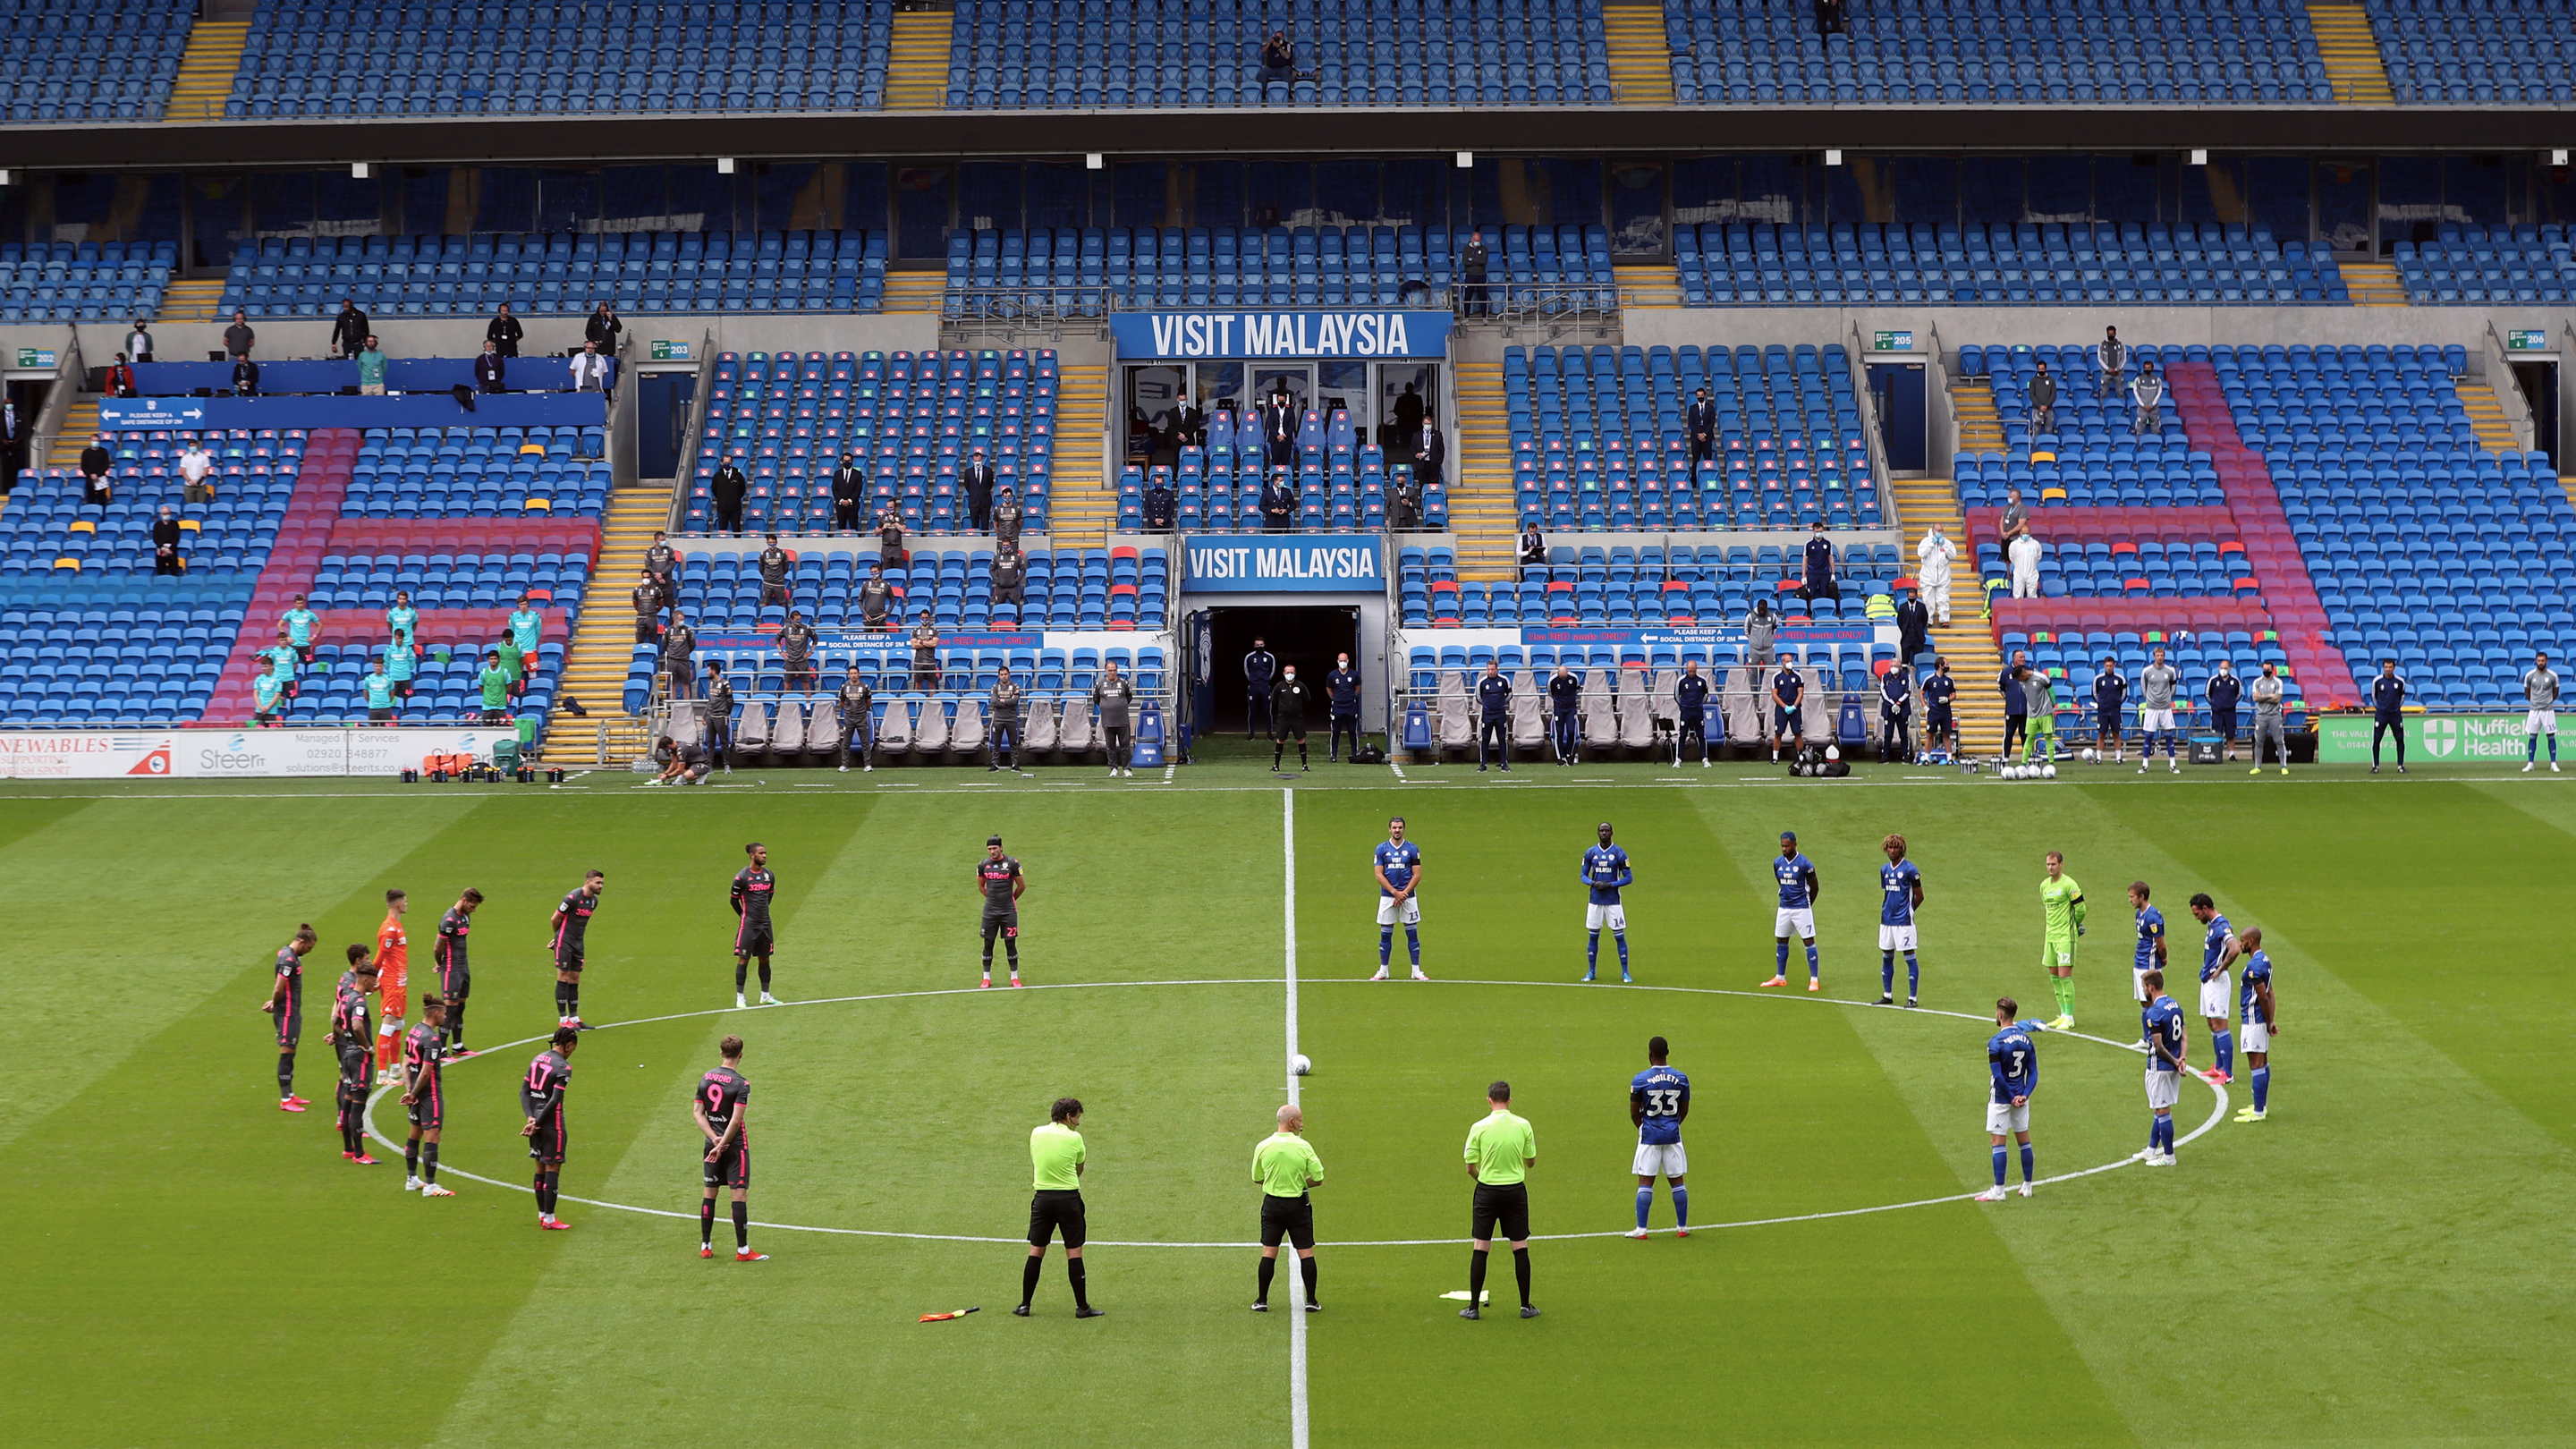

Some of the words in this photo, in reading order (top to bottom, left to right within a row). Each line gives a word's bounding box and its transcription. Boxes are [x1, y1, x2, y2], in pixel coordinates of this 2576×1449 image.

[1151, 315, 1235, 356] VISIT
[1244, 314, 1409, 355] MALAYSIA
[1894, 336, 1911, 344] 205
[2528, 335, 2544, 343] 206
[671, 345, 688, 354] 203
[1190, 548, 1250, 579] VISIT
[1256, 547, 1375, 578] MALAYSIA
[1528, 632, 1546, 640] Use
[1548, 632, 1570, 640] RED
[1572, 632, 1598, 640] seats
[1784, 631, 1806, 639] RED
[696, 639, 715, 647] Use
[717, 638, 739, 647] RED
[741, 639, 767, 647] seats
[953, 637, 974, 645] RED
[977, 637, 1003, 645] seats
[2463, 719, 2527, 736] Nuffiel
[296, 734, 340, 745] Managed
[358, 734, 400, 743] Services
[0, 739, 108, 753] NEWABLES
[2463, 738, 2526, 755] Health
[2, 755, 69, 764] SUPPORTING
[201, 749, 259, 769] Steer
[307, 750, 342, 758] 02920
[0, 766, 35, 775] WELSH
[38, 766, 72, 775] SPORT
[1614, 917, 1624, 928] 14
[1807, 924, 1812, 935] 7
[1903, 936, 1911, 948] 2
[2059, 953, 2071, 964] 12
[2209, 1003, 2216, 1013] 4
[2172, 1013, 2182, 1041] 8
[2008, 1051, 2025, 1078] 3
[530, 1062, 554, 1090] 17
[704, 1072, 733, 1084] BAMFORD
[1650, 1073, 1680, 1085] HOILETT
[707, 1083, 724, 1113] 9
[1646, 1089, 1682, 1116] 33
